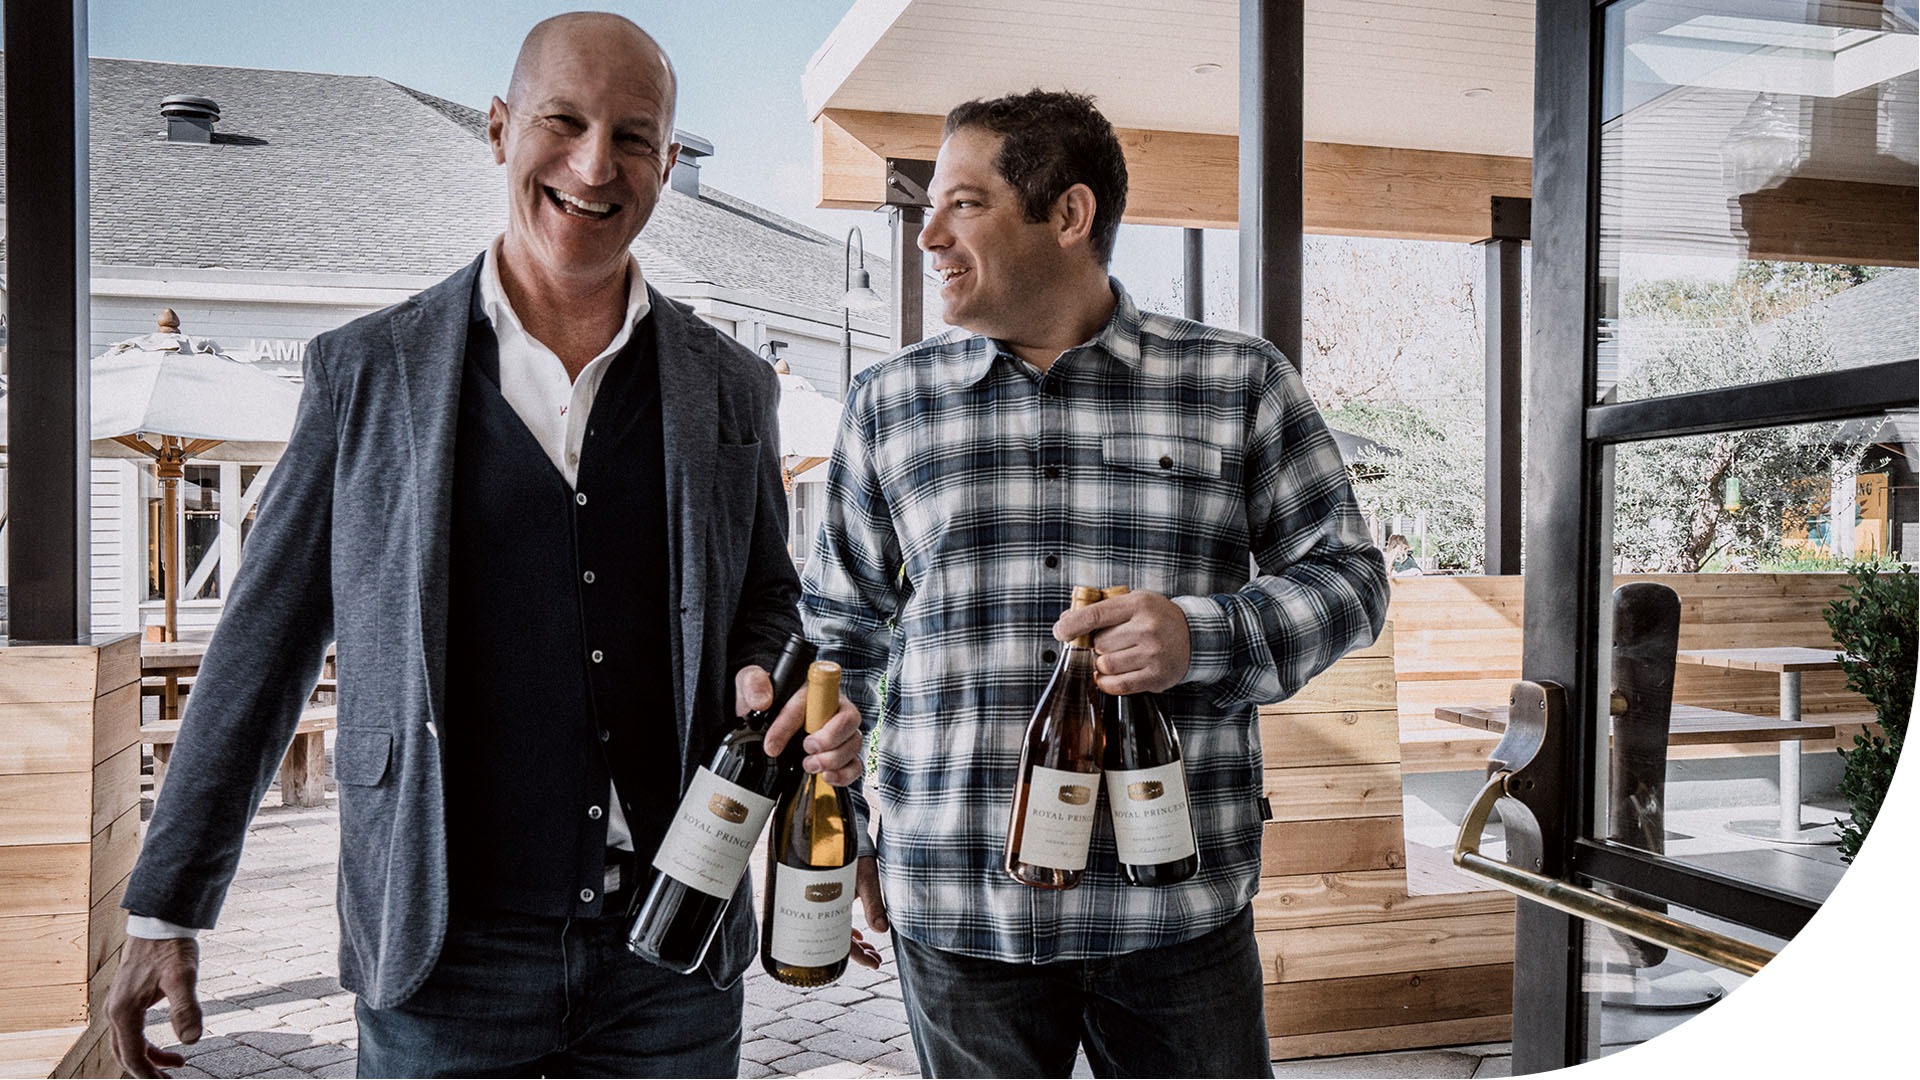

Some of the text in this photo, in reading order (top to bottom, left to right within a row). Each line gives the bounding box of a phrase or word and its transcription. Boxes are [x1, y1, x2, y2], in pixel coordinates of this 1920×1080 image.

[1032, 808, 1064, 821] ROYAL
[682, 812, 712, 835] ROYAL
[779, 905, 813, 920] ROYAL
